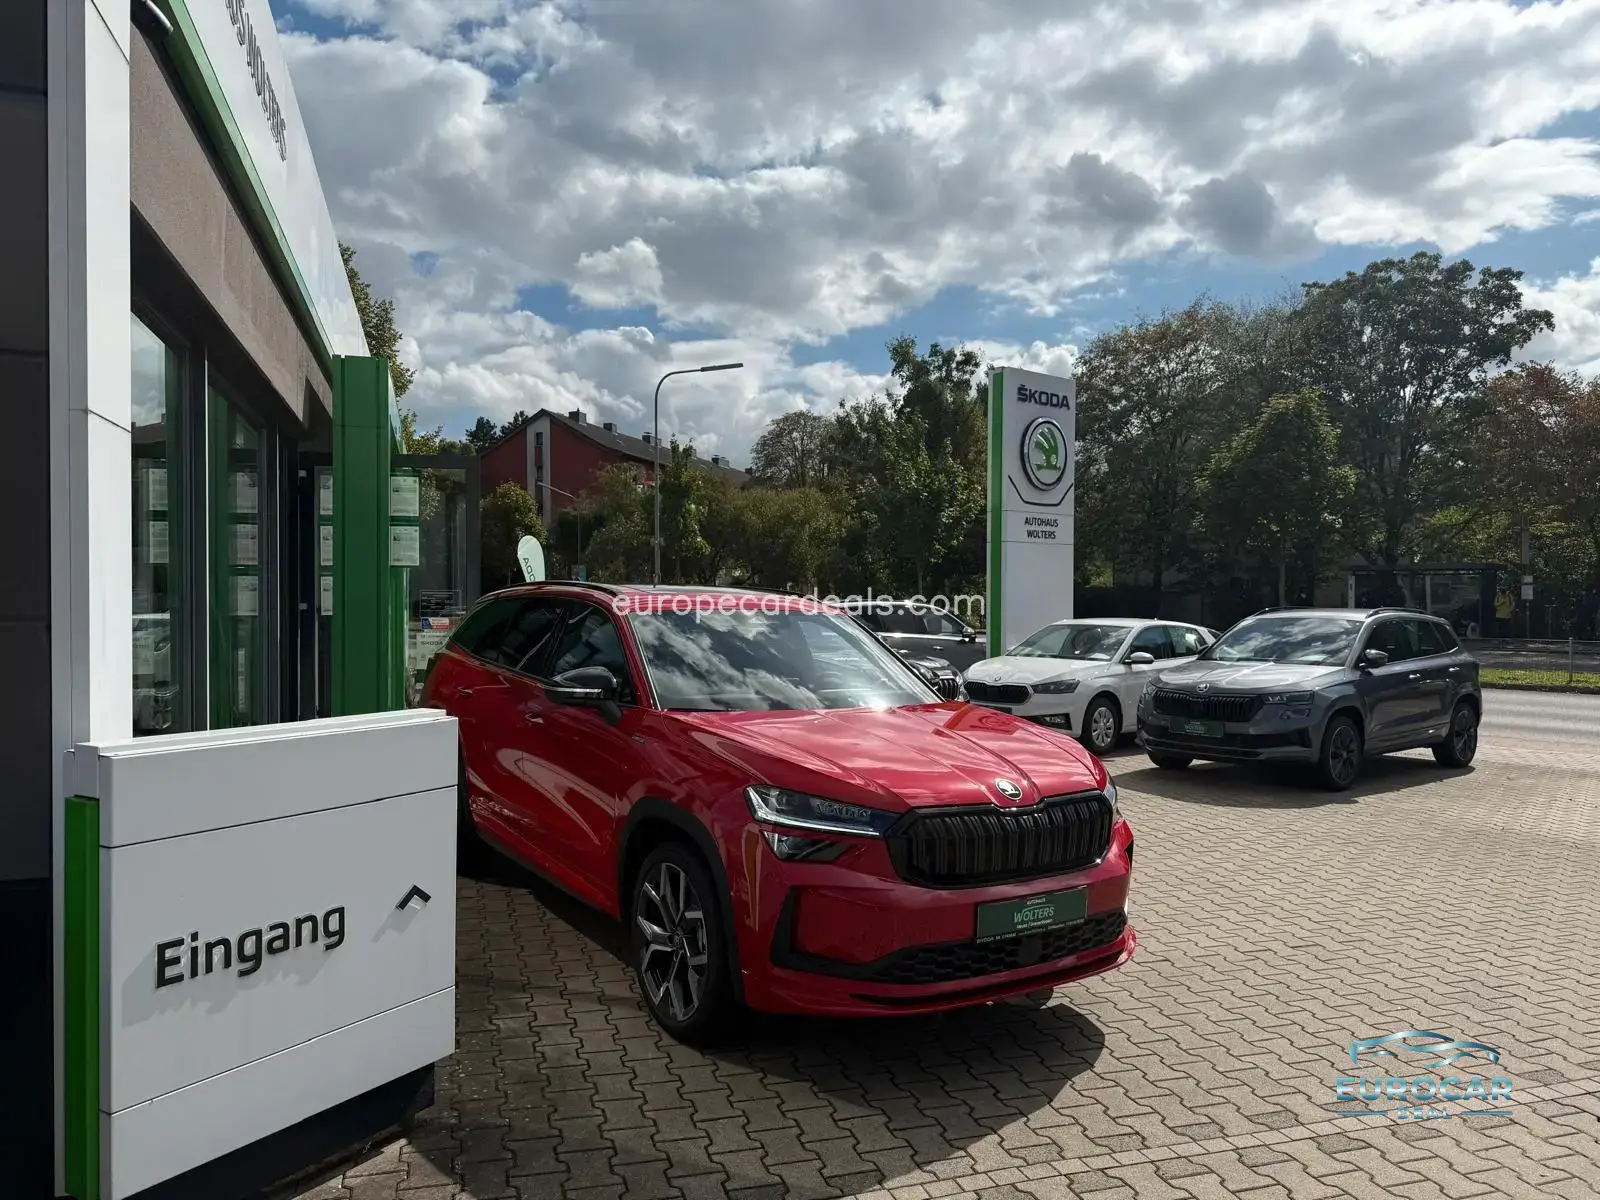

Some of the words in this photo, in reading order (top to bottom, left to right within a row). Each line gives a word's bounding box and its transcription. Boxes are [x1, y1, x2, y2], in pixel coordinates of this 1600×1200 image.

[1017, 384, 1070, 410] ŠKODA
[1024, 516, 1059, 528] AUTOHAUS
[1026, 529, 1057, 540] WOLTERS
[1014, 906, 1055, 923] WOLTERS
[155, 905, 346, 989] Eingang
